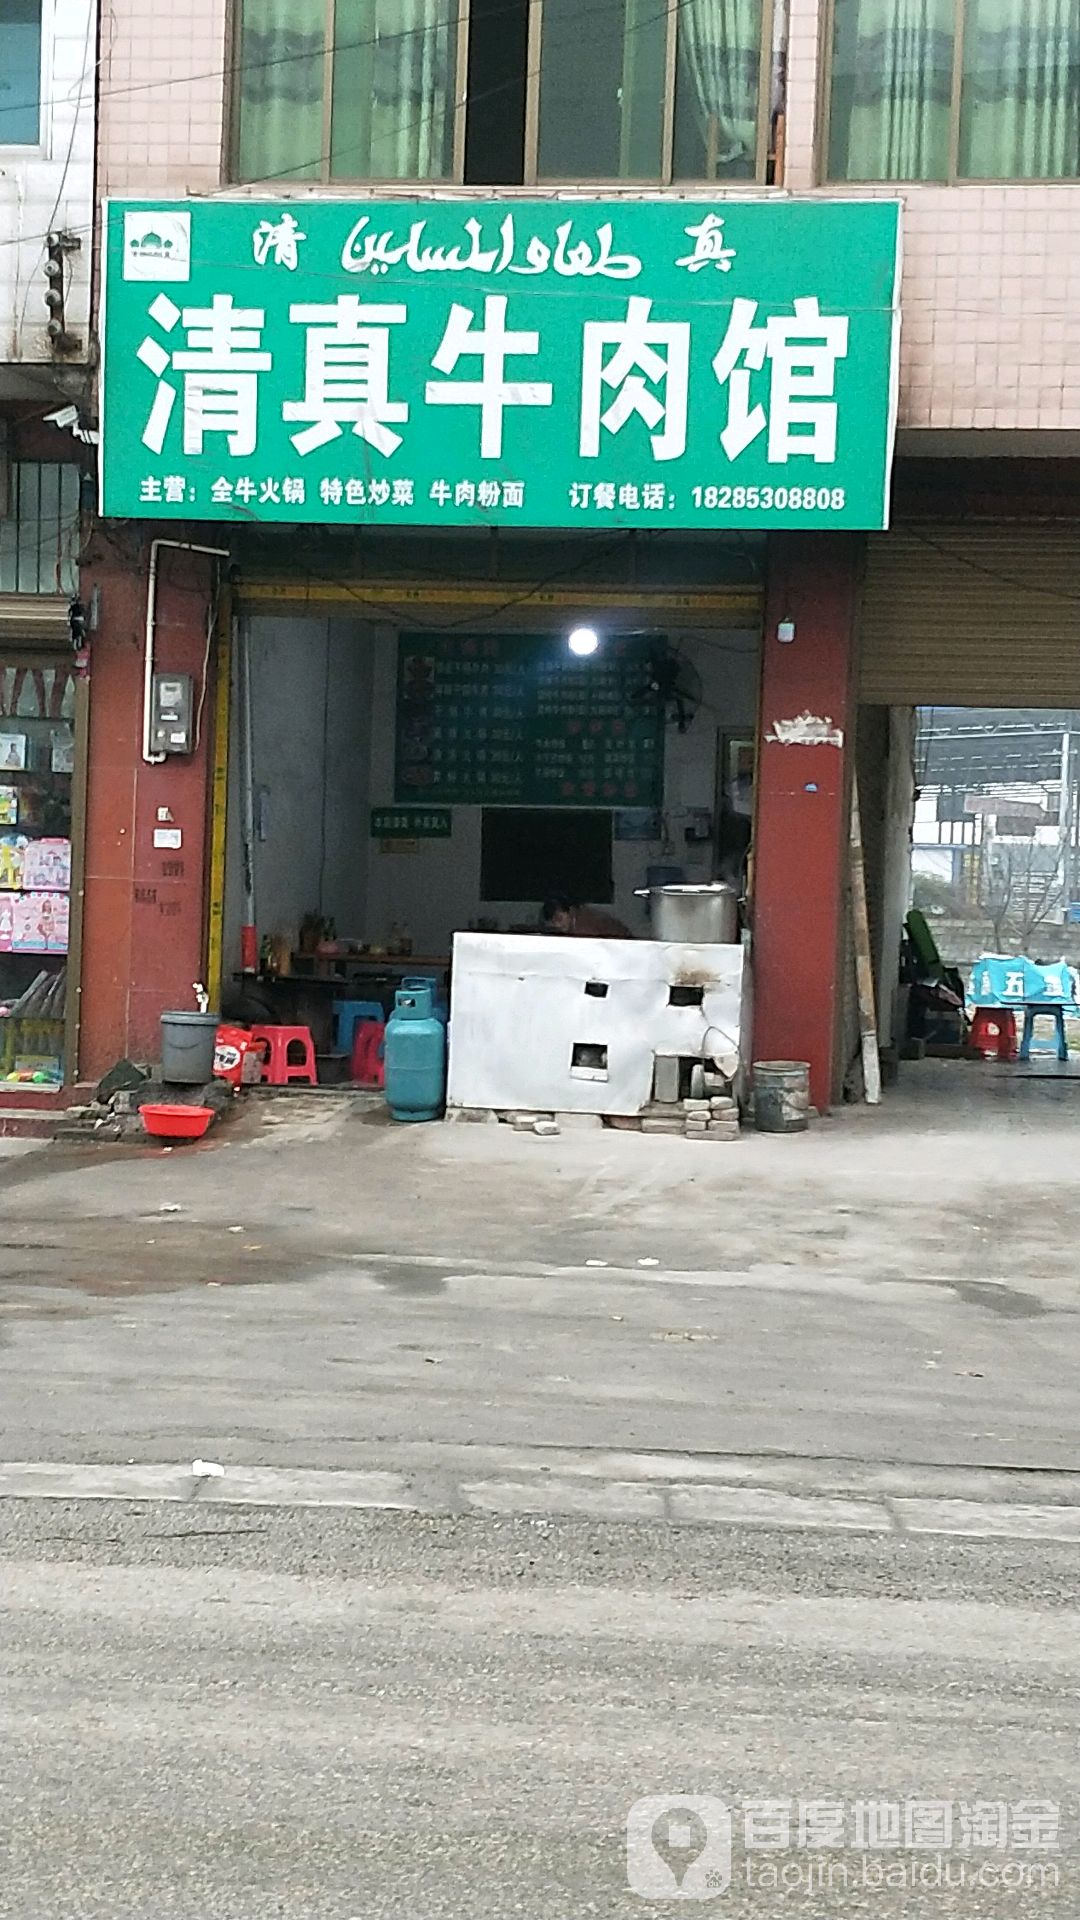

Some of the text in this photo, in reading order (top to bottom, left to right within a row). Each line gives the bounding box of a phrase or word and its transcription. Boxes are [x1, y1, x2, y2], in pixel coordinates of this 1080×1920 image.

[253, 214, 306, 270] 清
[676, 214, 736, 272] 真
[137, 294, 848, 462] 清真牛肉馆
[212, 477, 304, 503] 全牛火锅
[321, 479, 413, 505] 特色炒菜
[431, 480, 524, 507] 牛肉粉面
[693, 487, 844, 509] 18285308808
